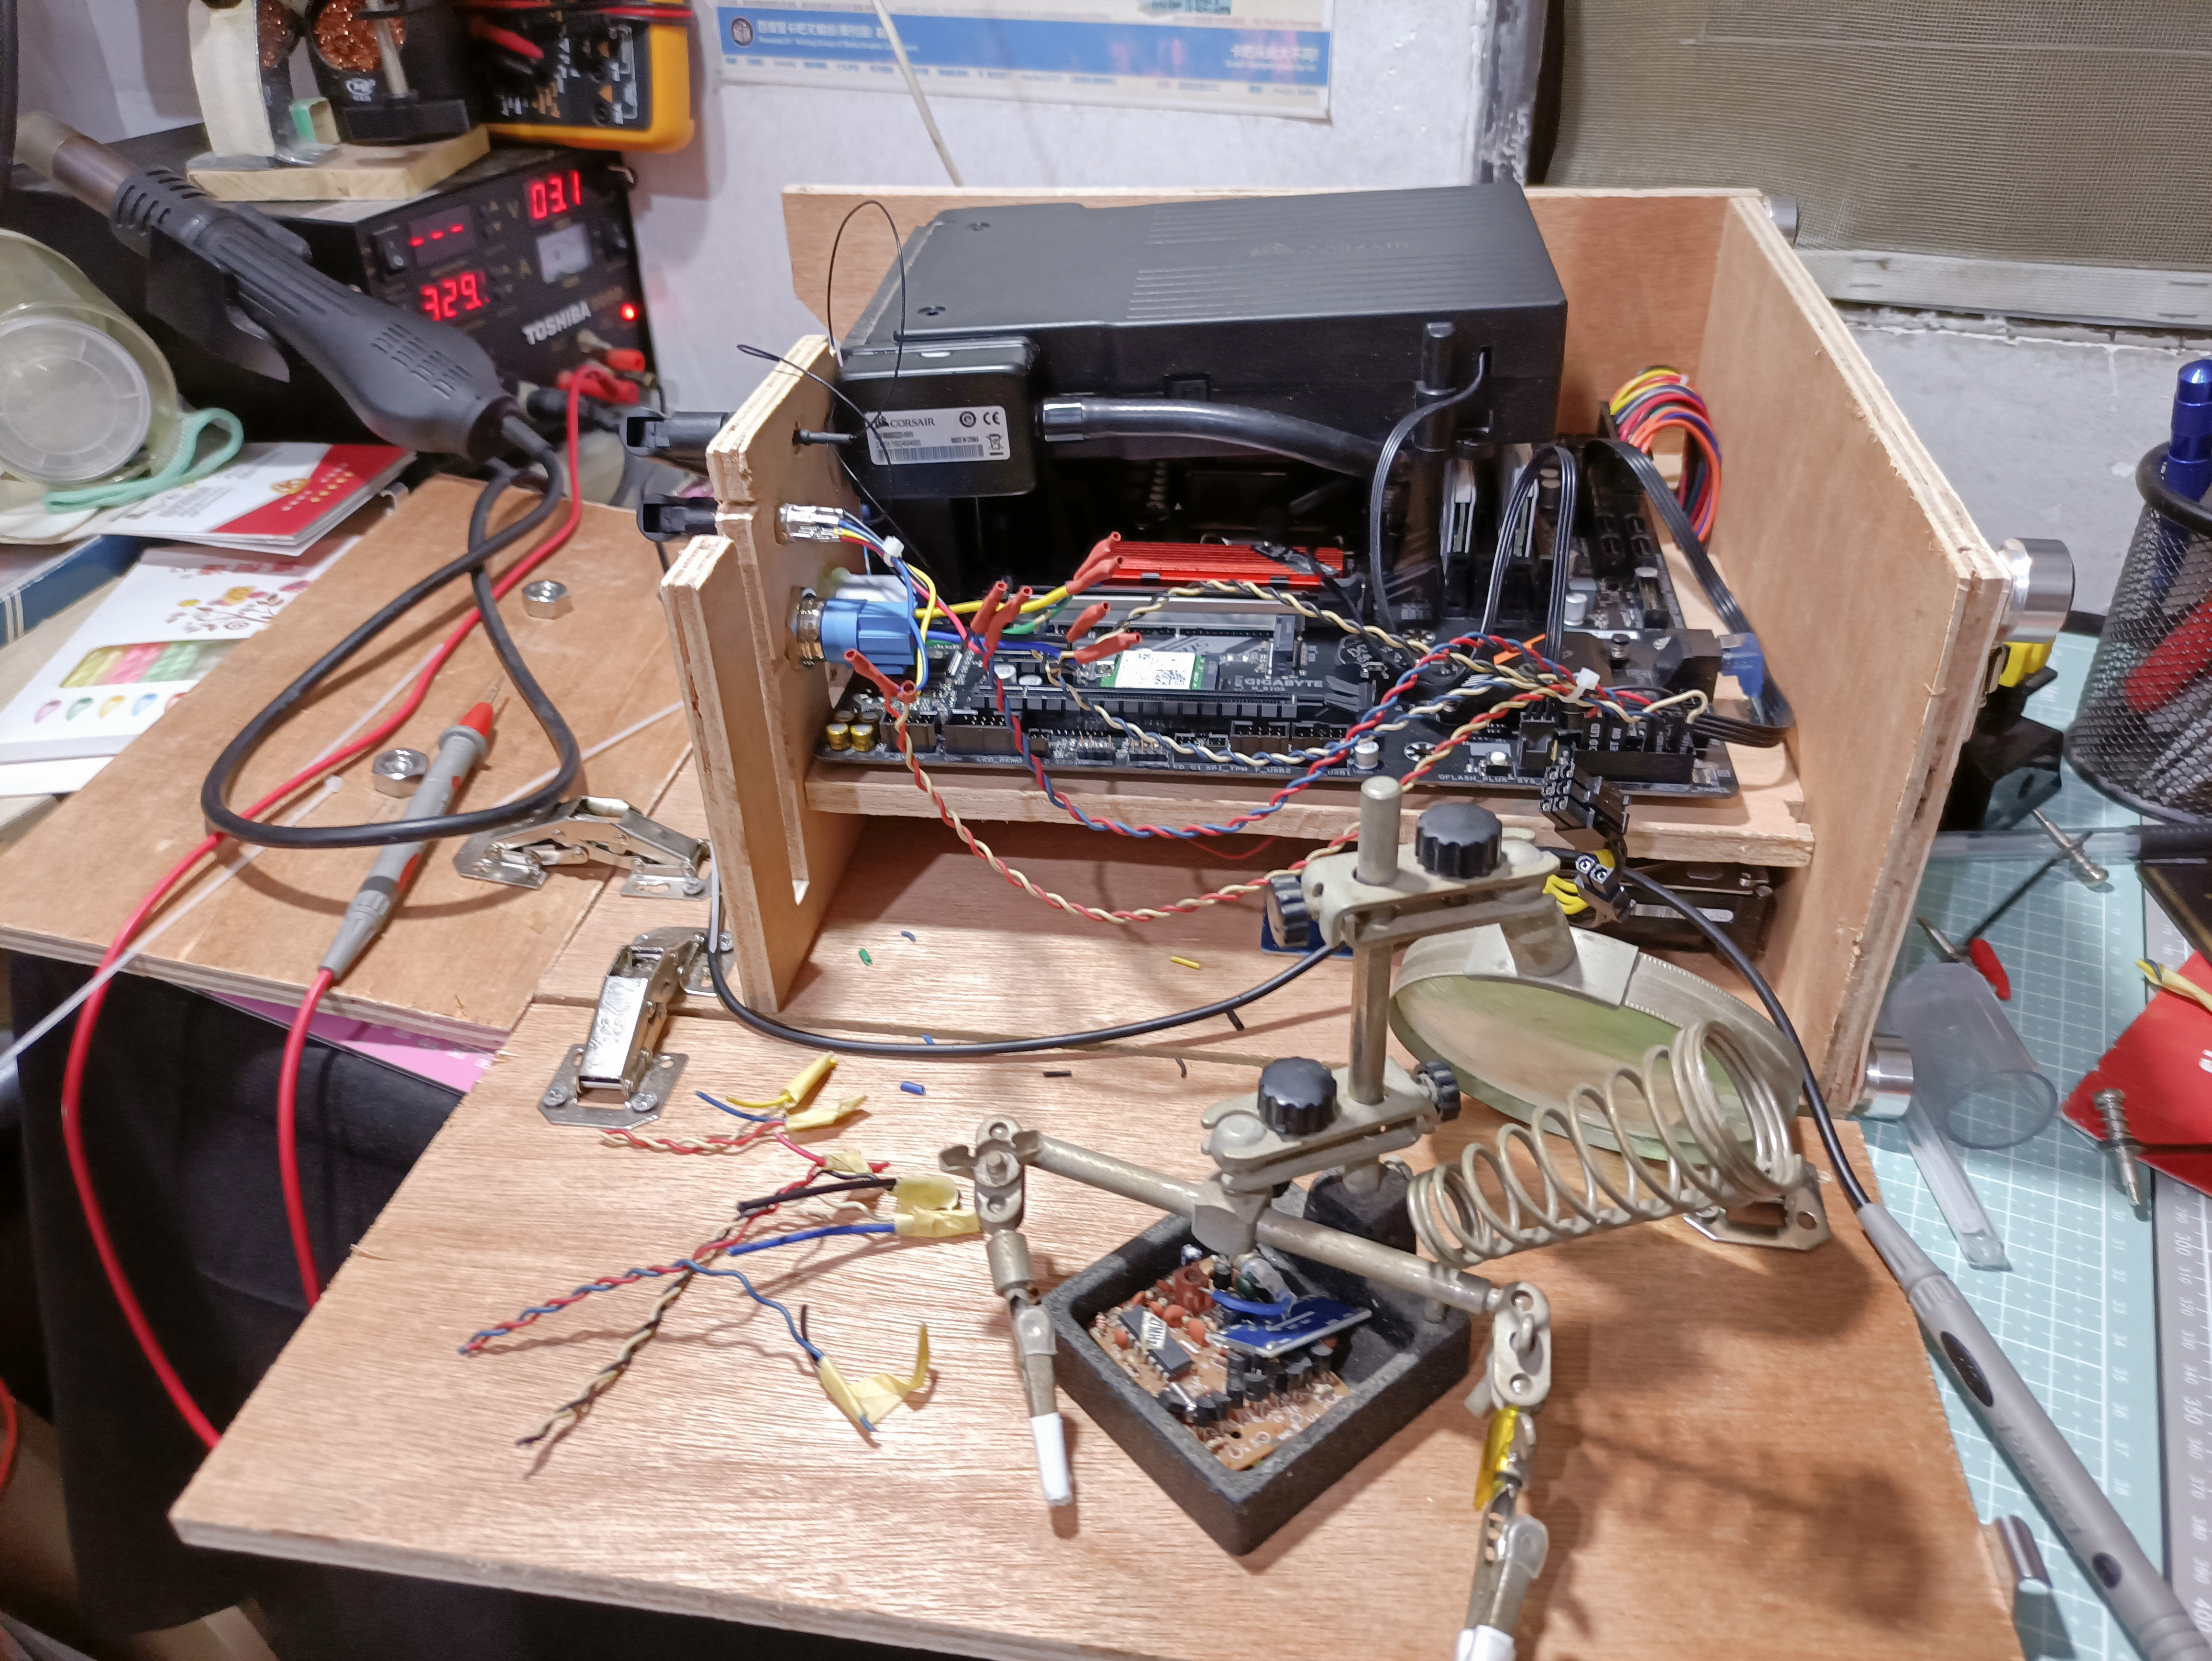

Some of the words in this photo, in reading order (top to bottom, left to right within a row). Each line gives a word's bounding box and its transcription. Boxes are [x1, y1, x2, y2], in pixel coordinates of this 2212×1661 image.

[522, 300, 592, 345] TOSHIBA
[890, 417, 936, 428] CORSAIR
[1244, 677, 1323, 688] GIGABYTE
[1206, 764, 1249, 773] SPI_TPM
[1255, 764, 1292, 774] F_USB2
[2111, 1208, 2125, 1222] 30
[2174, 1205, 2190, 1224] 290
[2111, 1237, 2126, 1251] 31
[2173, 1231, 2194, 1257] 300
[2111, 1268, 2127, 1284] 32
[2177, 1265, 2194, 1285] 310
[2111, 1299, 2127, 1315] 33
[2179, 1296, 2195, 1317] 320
[2112, 1332, 2128, 1348] 34
[2180, 1329, 2197, 1351] 330
[2112, 1366, 2128, 1383] 35
[2182, 1363, 2200, 1386] 340
[2112, 1401, 2128, 1419] 36
[2182, 1395, 2204, 1426] 350
[2113, 1440, 2130, 1458] 37
[2187, 1436, 2203, 1461] 360
[2113, 1477, 2132, 1497] 38
[2189, 1474, 2207, 1500] 370
